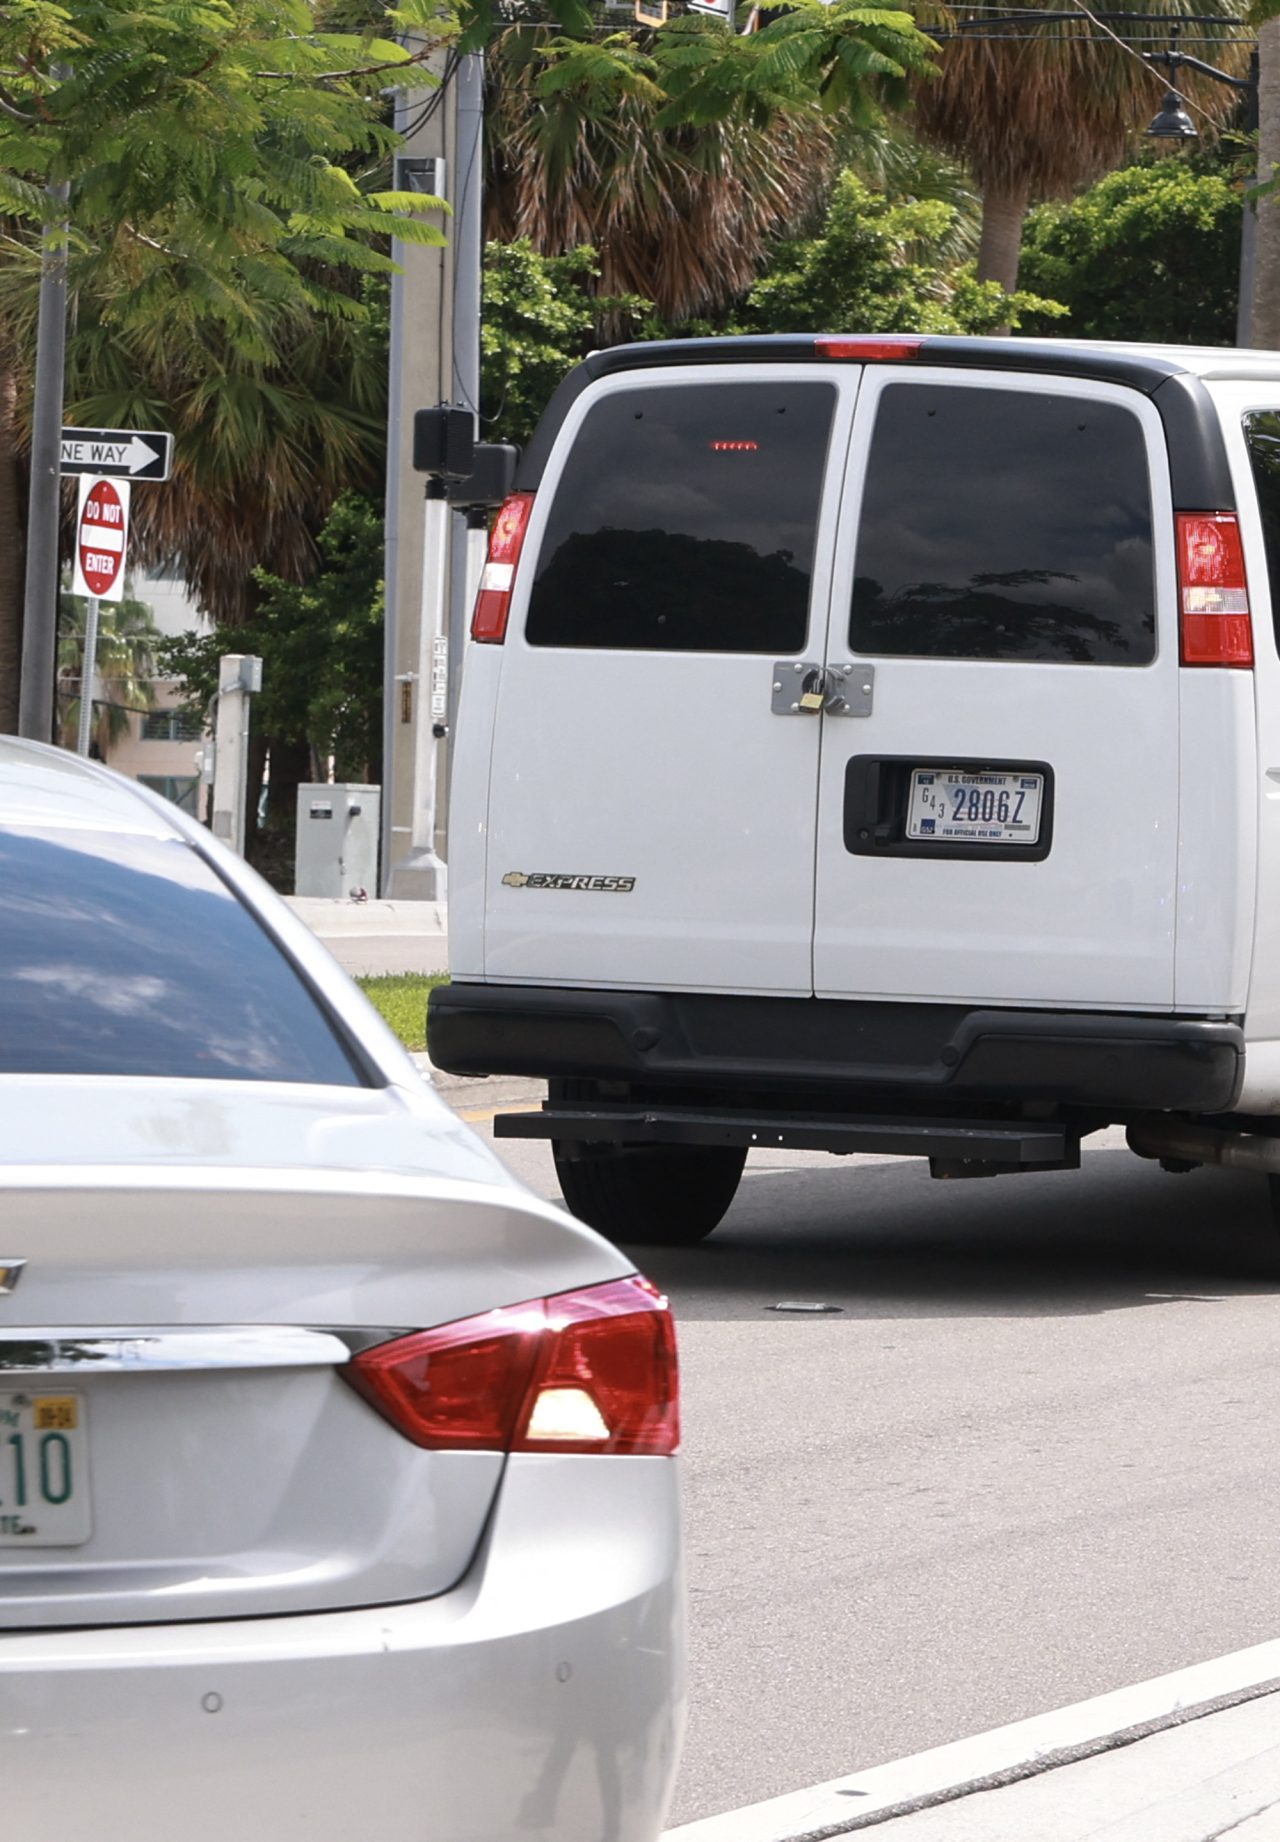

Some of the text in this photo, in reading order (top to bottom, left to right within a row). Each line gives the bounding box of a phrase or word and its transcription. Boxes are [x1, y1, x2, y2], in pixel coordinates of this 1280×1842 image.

[60, 443, 128, 463] NE WAY
[86, 500, 121, 523] DO NOT
[85, 552, 115, 575] ENTER
[948, 774, 1007, 786] U.S. GOVERNMENT
[952, 788, 1026, 824] 2806Z
[942, 828, 953, 836] FOR
[529, 873, 634, 891] EXPRESS
[0, 1431, 73, 1507] 10
